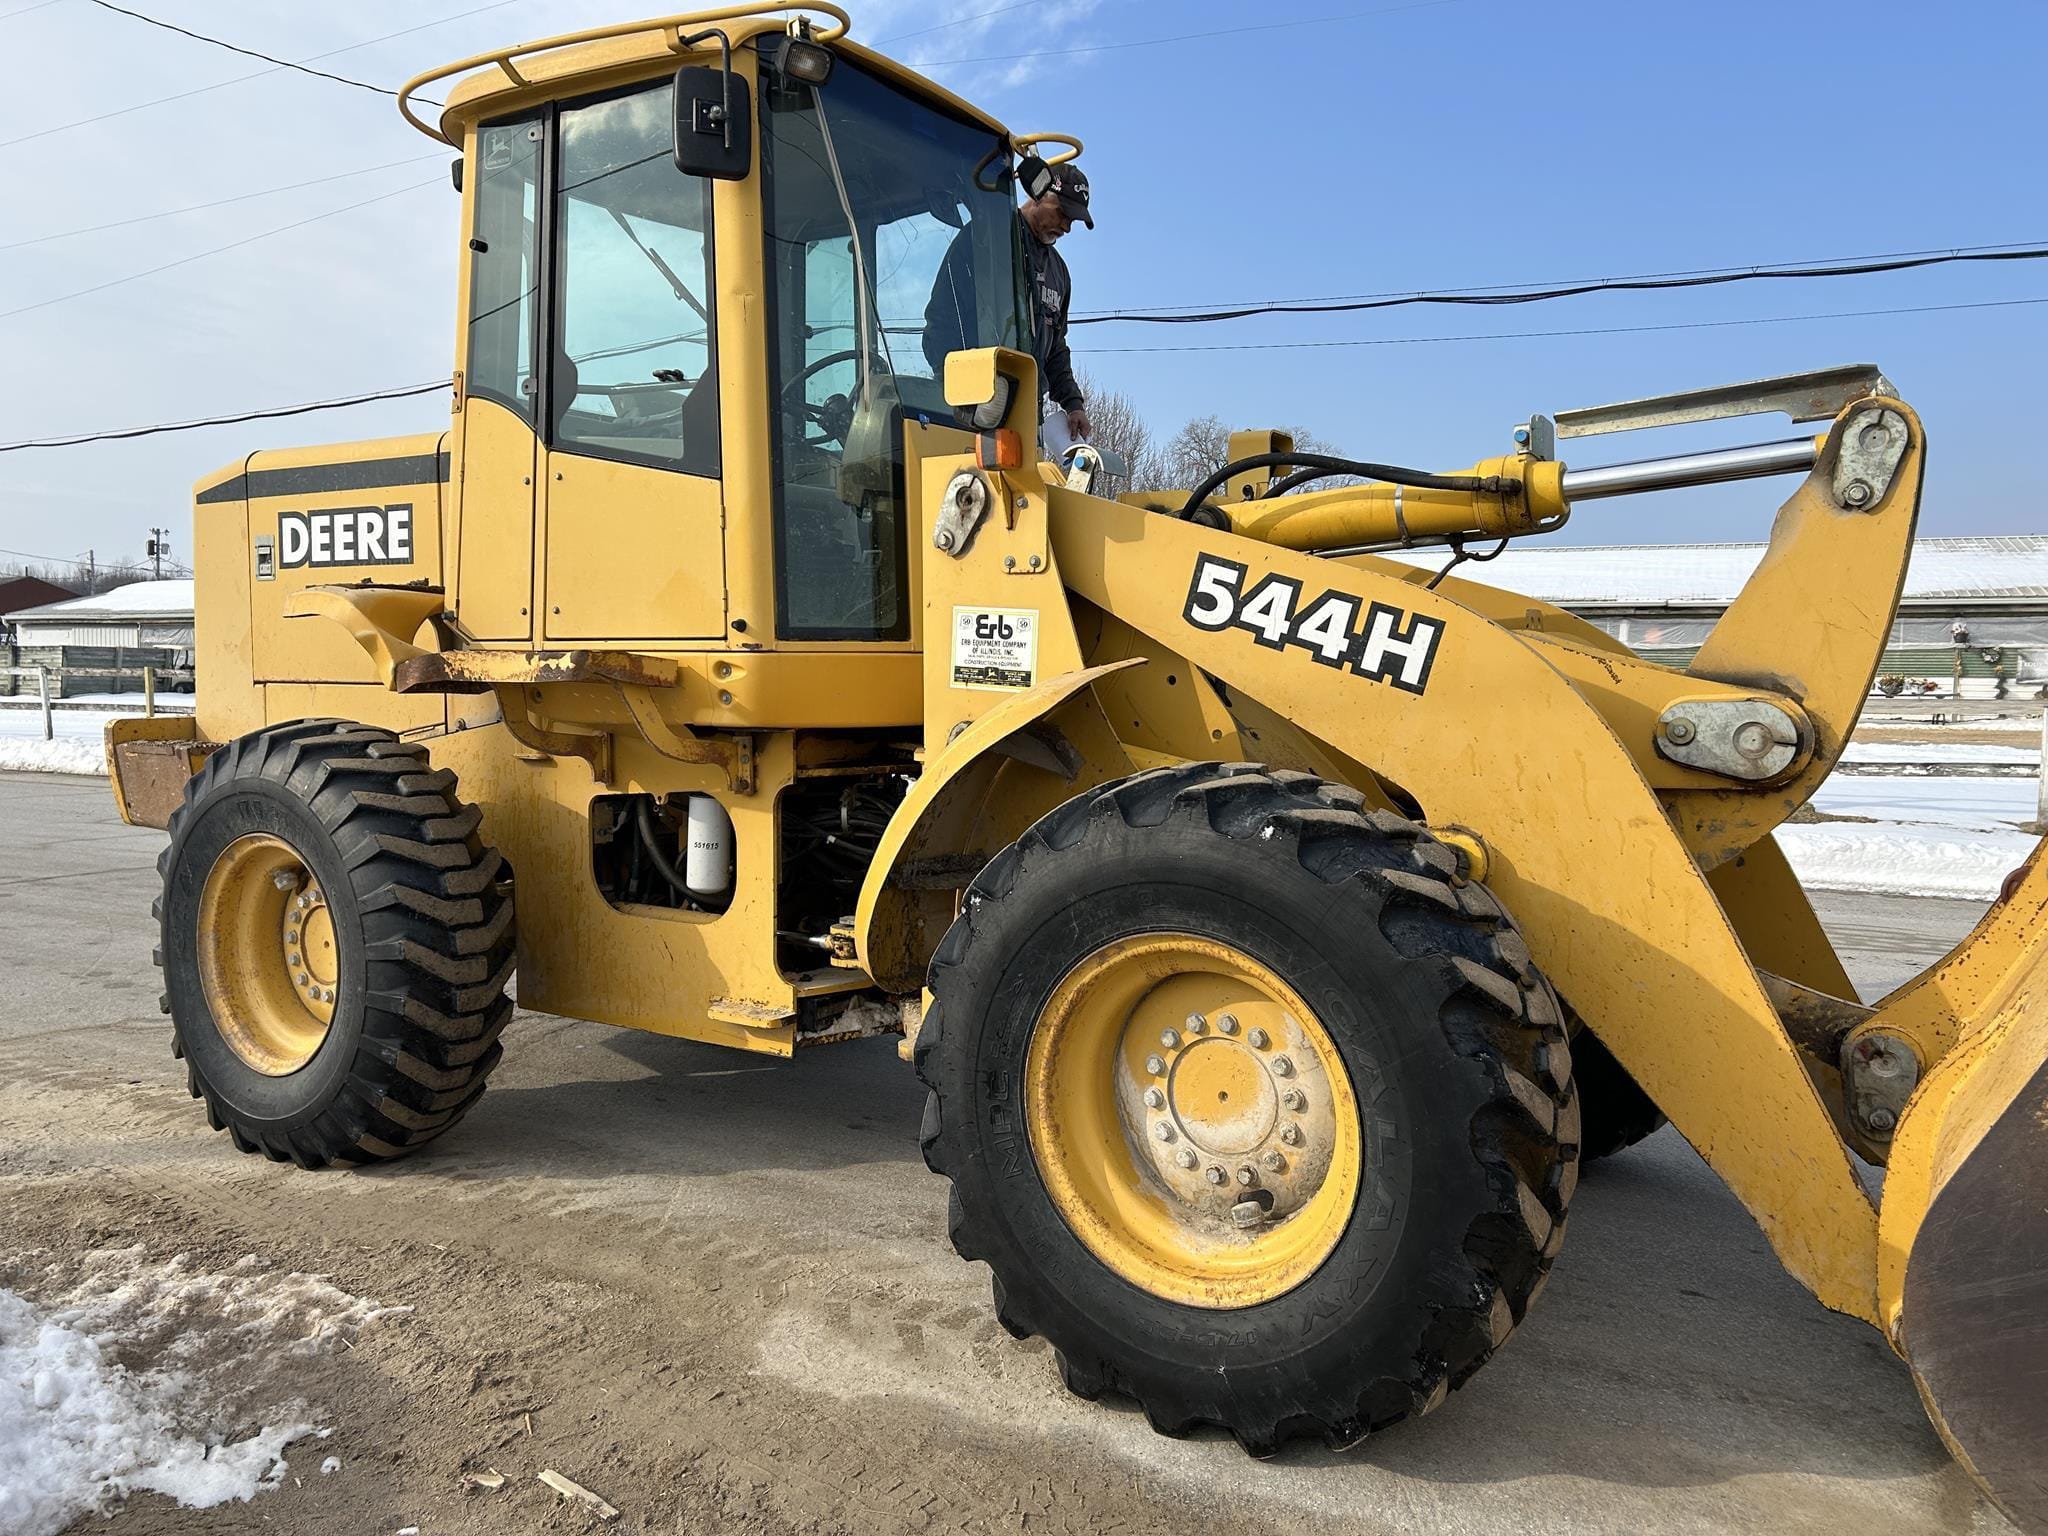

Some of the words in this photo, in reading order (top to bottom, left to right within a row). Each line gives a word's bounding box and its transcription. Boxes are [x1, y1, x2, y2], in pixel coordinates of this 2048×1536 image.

[279, 506, 413, 566] DEERE
[976, 614, 1013, 640] Erb
[1187, 557, 1440, 690] 544H
[972, 639, 1001, 648] EQUIPMENT
[1002, 640, 1027, 649] COMPANY
[694, 842, 719, 850] 551615
